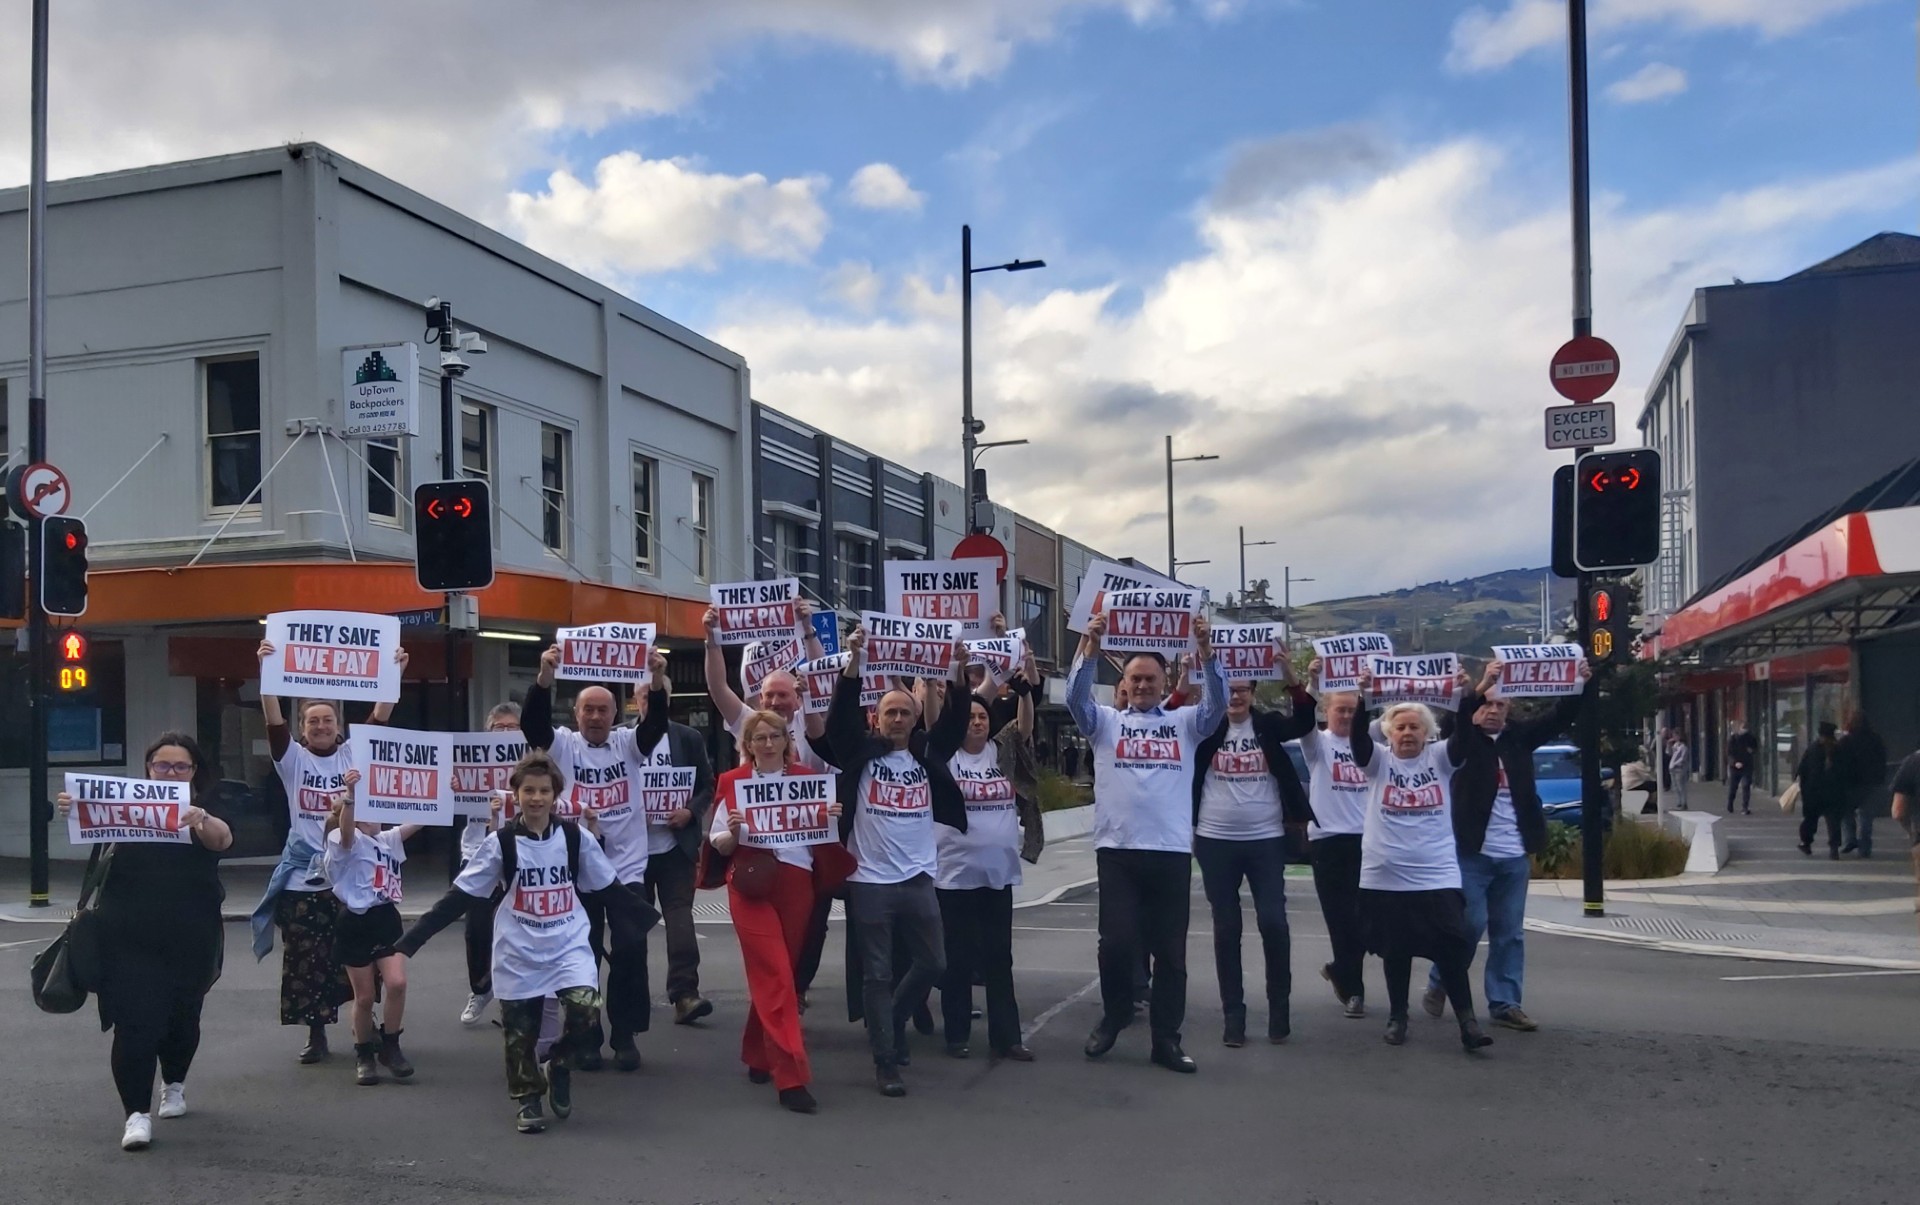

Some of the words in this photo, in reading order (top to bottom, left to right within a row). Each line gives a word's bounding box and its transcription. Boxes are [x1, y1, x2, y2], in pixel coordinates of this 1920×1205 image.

[1563, 366, 1574, 376] NO
[1580, 362, 1606, 374] ENTRY
[360, 385, 395, 397] UpTown
[350, 398, 404, 410] Backpackers
[1554, 410, 1606, 425] EXCEPT
[348, 426, 360, 434] Call
[1553, 426, 1608, 442] CYCLES
[901, 572, 939, 590] THEY
[942, 572, 978, 590] SAVE
[718, 587, 756, 605] THEY
[760, 584, 792, 602] SAVE
[1112, 592, 1151, 606] THEY
[1154, 592, 1192, 608] SAVE
[908, 596, 937, 617] WE
[940, 595, 972, 617] PAY
[397, 614, 421, 626] oray
[424, 611, 434, 622] Pl
[726, 608, 755, 629] WE
[758, 605, 788, 627] PAY
[964, 622, 979, 630] CUTS
[1116, 612, 1148, 634] WE
[1150, 612, 1183, 636] PAY
[286, 623, 334, 643] THEY
[338, 626, 380, 647] SAVE
[566, 626, 606, 638] THEY
[610, 626, 647, 640] SAVE
[722, 630, 756, 641] HOSPITAL
[758, 629, 776, 637] CUTS
[778, 628, 795, 636] HURT
[869, 618, 910, 637] THEY
[914, 623, 952, 640] SAVE
[1209, 630, 1234, 643] HEY
[1238, 628, 1274, 643] SAVE
[977, 640, 1012, 654] SAVE
[1108, 637, 1144, 647] HOSPITAL
[1146, 638, 1166, 648] CUTS
[1168, 640, 1189, 648] HURT
[1320, 637, 1355, 654] THEY
[1359, 636, 1388, 650] SAVE
[1594, 632, 1612, 656] 09
[294, 646, 330, 672] WE
[332, 650, 371, 675] PAY
[571, 640, 602, 664] WE
[606, 642, 640, 666] PAY
[876, 642, 906, 660] WE
[910, 644, 945, 666] PAY
[1234, 648, 1266, 667] PAY
[1500, 648, 1538, 659] THEY
[1541, 646, 1576, 658] SAVE
[748, 658, 773, 681] WE
[774, 644, 794, 668] PAY
[866, 662, 904, 672] HOSPITAL
[906, 664, 926, 674] CUTS
[926, 668, 948, 676] HURT
[1330, 657, 1356, 676] WE
[1374, 658, 1413, 676] THEY
[1416, 658, 1452, 676] SAVE
[61, 668, 86, 688] 09
[562, 666, 600, 678] HOSPITAL
[602, 669, 622, 678] CUTS
[624, 670, 644, 679] HURT
[1232, 670, 1253, 678] CUTS
[1510, 662, 1536, 682] WE
[1538, 662, 1568, 681] PAY
[284, 676, 293, 684] NO
[294, 676, 324, 686] DUNEDIN
[326, 678, 358, 688] HOSPITAL
[360, 680, 378, 689] CUTS
[1325, 680, 1355, 688] HOSPITAL
[1380, 679, 1410, 696] WE
[1413, 679, 1446, 696] PAY
[1501, 685, 1533, 694] HOSPITAL
[811, 698, 830, 708] HOSP
[1372, 697, 1408, 705] HOSPITAL
[1152, 724, 1178, 738] SAVE
[369, 740, 402, 763] THEY
[405, 743, 438, 766] SAVE
[453, 744, 490, 763] THEY
[1124, 740, 1147, 758] WE
[1149, 742, 1175, 758] PAY
[302, 770, 326, 790] THEY
[374, 766, 400, 794] WE
[402, 768, 431, 796] PAY
[457, 768, 490, 790] WE
[573, 765, 602, 784] THEY
[604, 762, 628, 782] SAVE
[644, 772, 670, 788] THEY
[672, 772, 692, 787] SAVE
[1413, 767, 1438, 788] SAVE
[76, 778, 127, 799] THEY
[133, 784, 179, 800] SAVE
[578, 787, 599, 808] WE
[602, 782, 626, 806] PAY
[743, 782, 784, 804] THEY
[788, 780, 826, 800] SAVE
[877, 784, 901, 806] WE
[902, 784, 927, 807] PAY
[986, 780, 1010, 799] PAY
[303, 790, 328, 810] WE
[368, 800, 375, 808] NO
[376, 800, 396, 809] DUNEDIN
[397, 802, 422, 811] HOSPITAL
[423, 802, 438, 812] CUTS
[556, 798, 574, 814] AY
[646, 792, 666, 811] WE
[668, 791, 689, 810] PAY
[86, 803, 127, 826] WE
[128, 804, 170, 828] PAY
[752, 807, 784, 832] WE
[786, 804, 820, 830] PAY
[80, 828, 127, 838] HOSPITAL
[129, 828, 154, 838] CUTS
[748, 832, 784, 844] HOSPITAL
[784, 832, 806, 842] CUTS
[808, 830, 828, 840] HURT
[522, 891, 546, 915] WE
[548, 888, 572, 914] PAY
